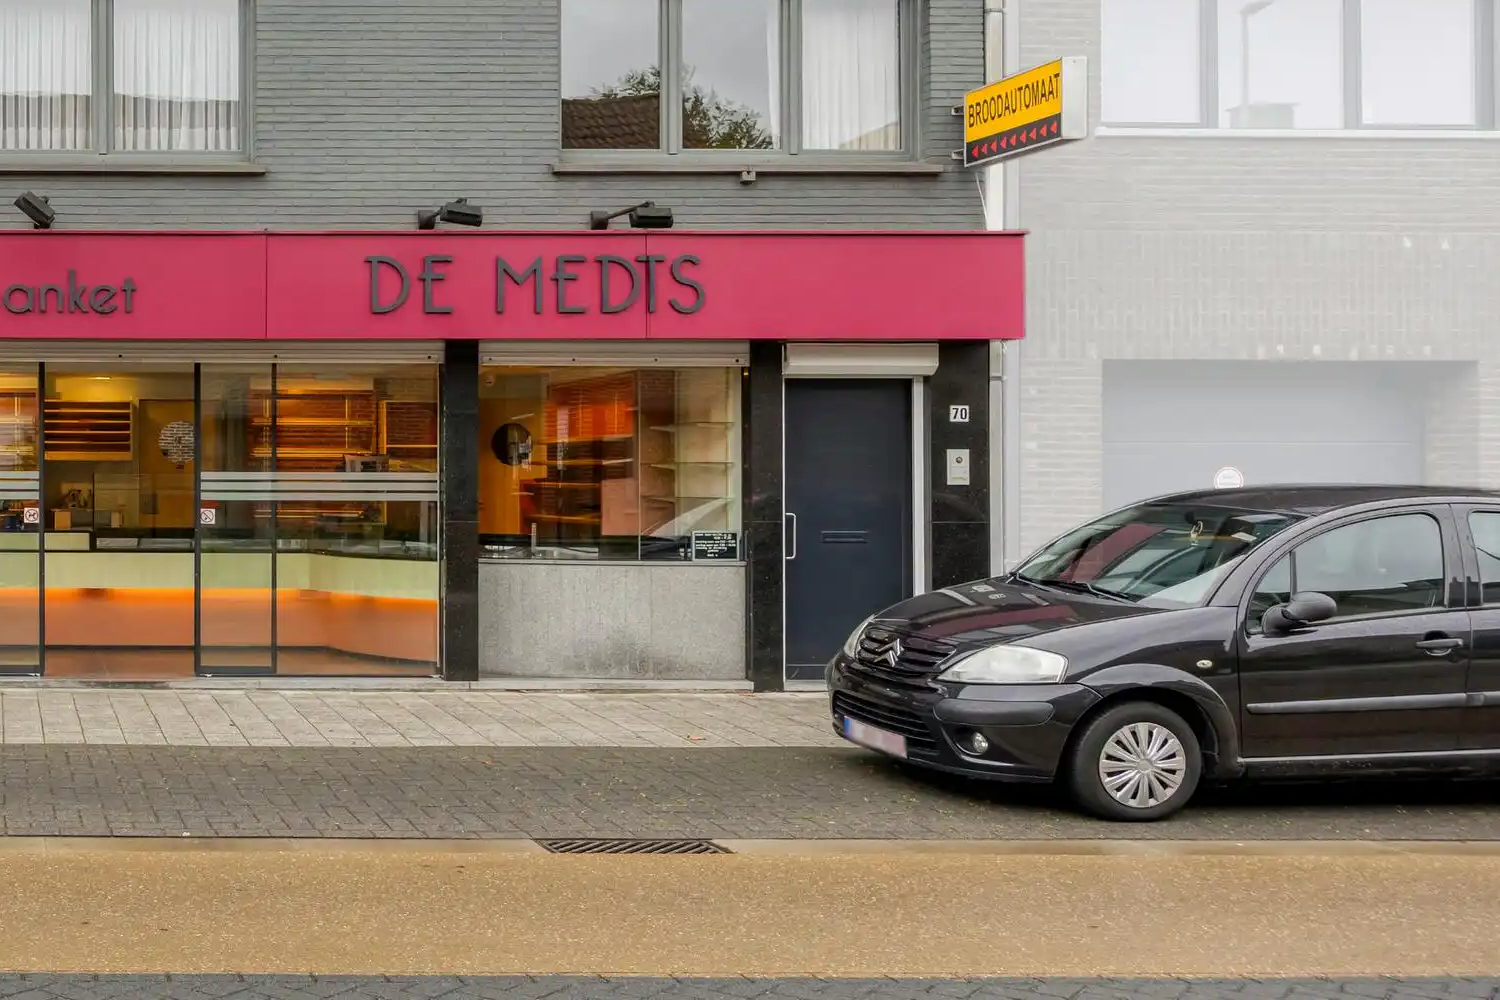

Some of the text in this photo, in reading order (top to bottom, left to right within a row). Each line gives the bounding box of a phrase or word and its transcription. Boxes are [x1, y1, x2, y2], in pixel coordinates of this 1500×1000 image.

[967, 73, 1060, 128] BROODAUTOMAAT
[363, 253, 706, 315] DE MEDTS
[952, 407, 968, 420] 70
